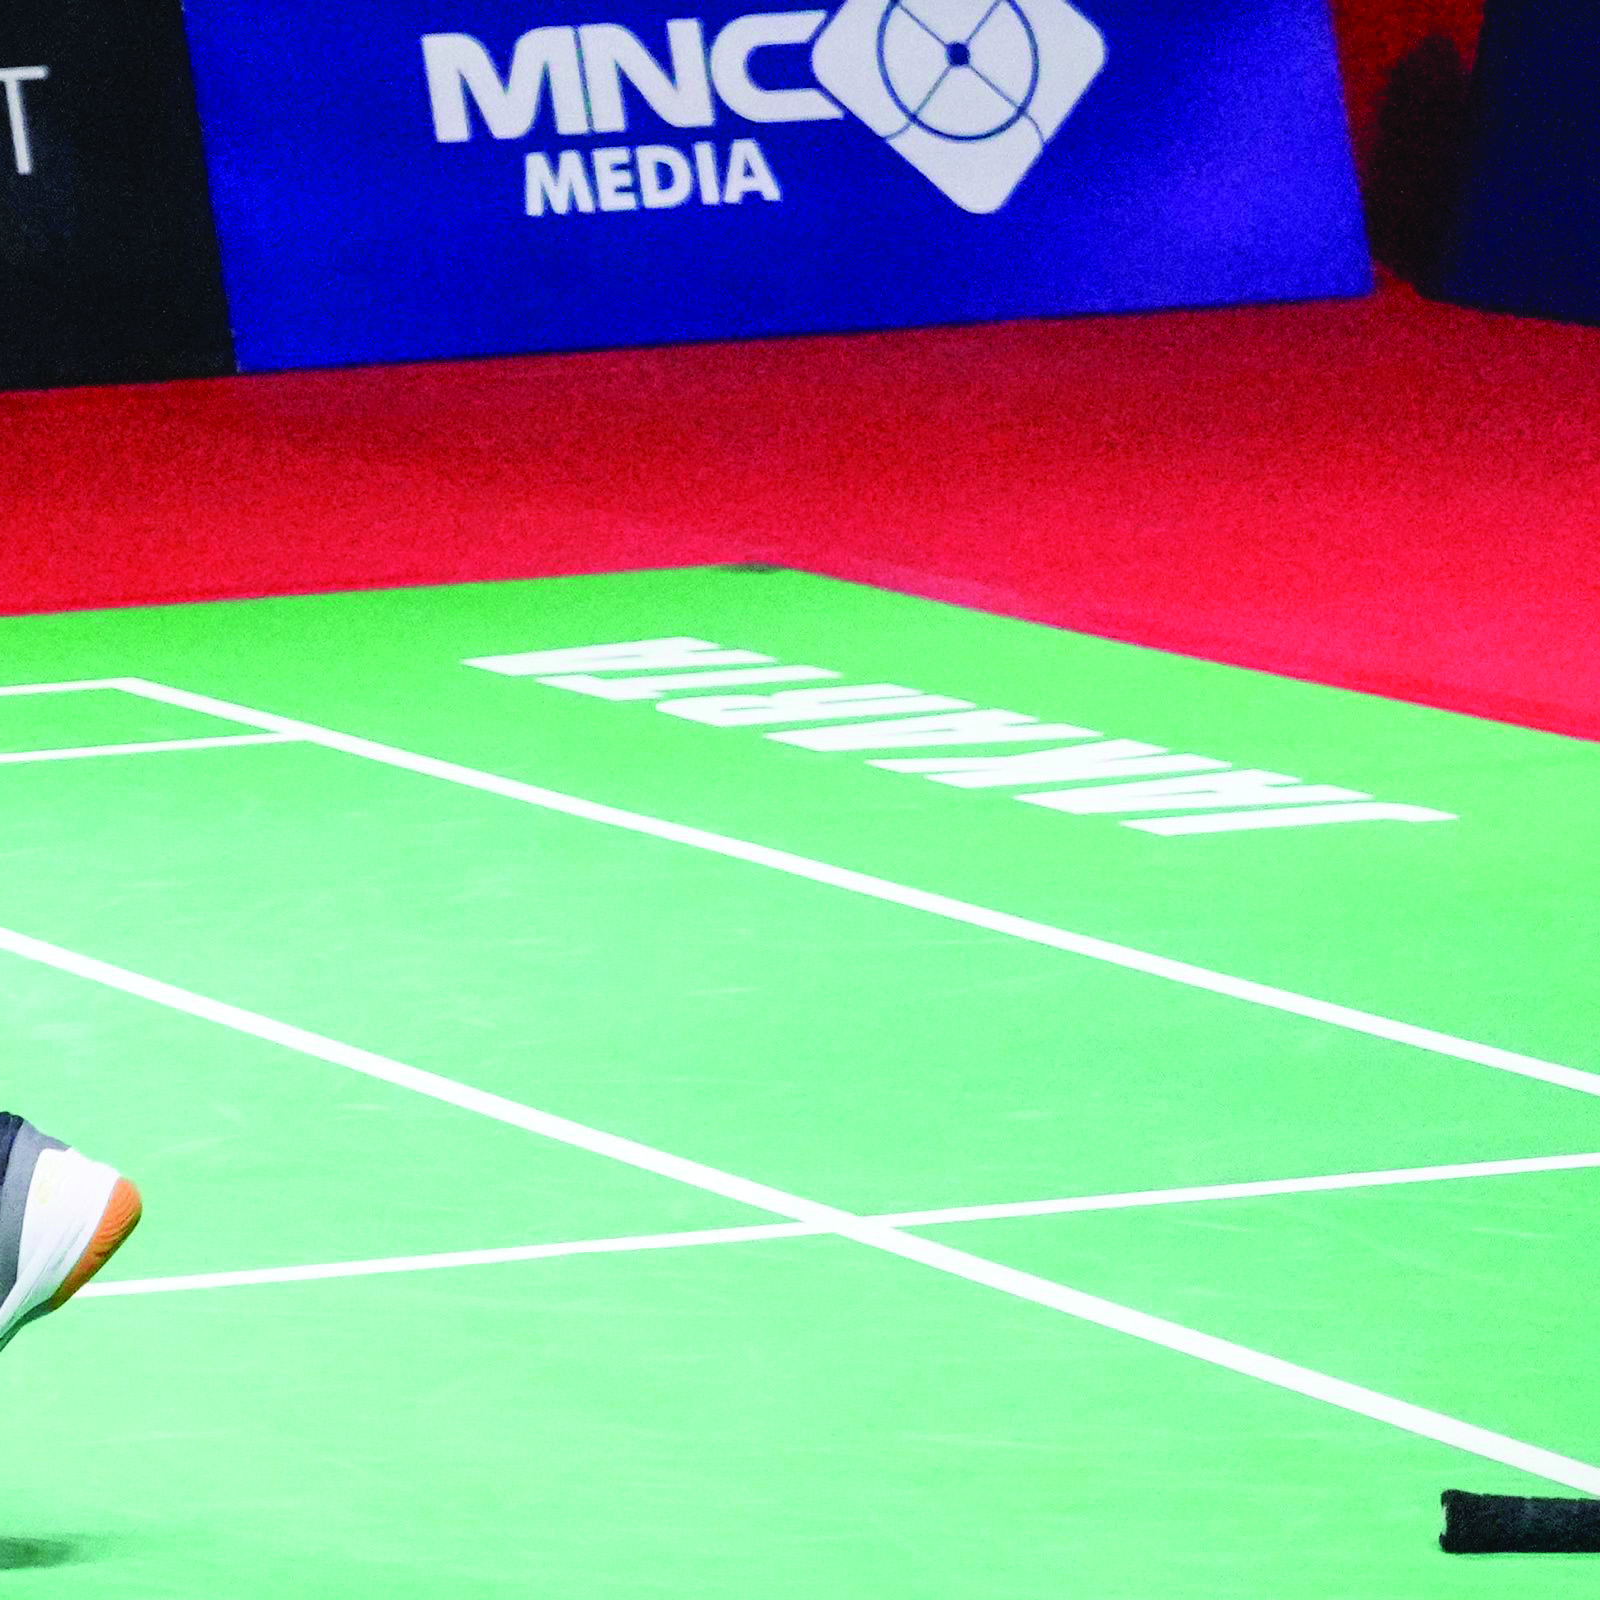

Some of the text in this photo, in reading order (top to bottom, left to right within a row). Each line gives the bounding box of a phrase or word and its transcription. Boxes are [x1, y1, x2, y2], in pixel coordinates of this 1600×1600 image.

[420, 9, 845, 144] MNC
[524, 138, 782, 218] MEDIA
[460, 635, 1460, 837] JAKARTA
